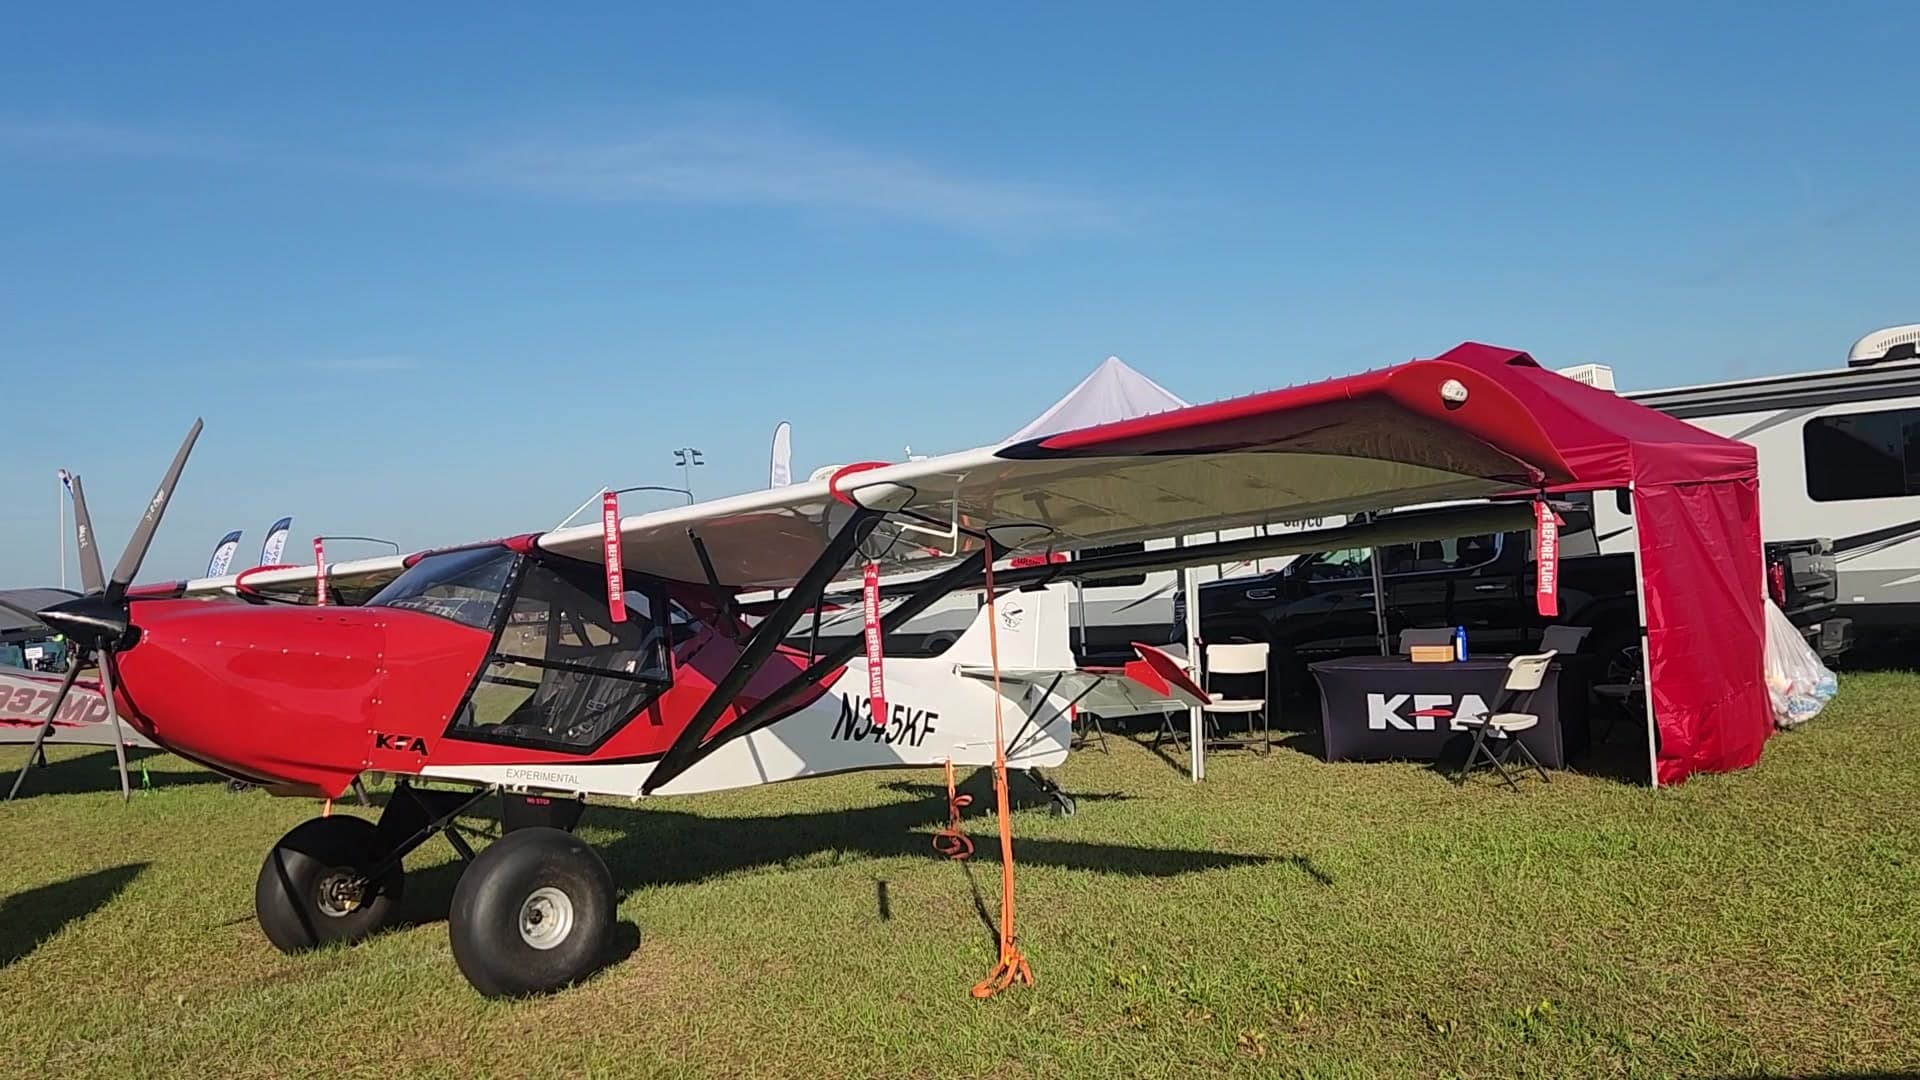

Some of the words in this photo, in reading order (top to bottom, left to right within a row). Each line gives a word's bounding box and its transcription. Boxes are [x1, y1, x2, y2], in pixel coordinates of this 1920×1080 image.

[1541, 522, 1555, 559] BEFORE
[1540, 561, 1554, 594] FLIGHT
[865, 585, 876, 625] REMOVE
[868, 628, 881, 664] BEFORE
[871, 666, 883, 698] FLIGHT
[1367, 693, 1508, 739] KFA
[376, 733, 429, 756] KFA
[506, 768, 580, 785] EXPERIMENTAL
